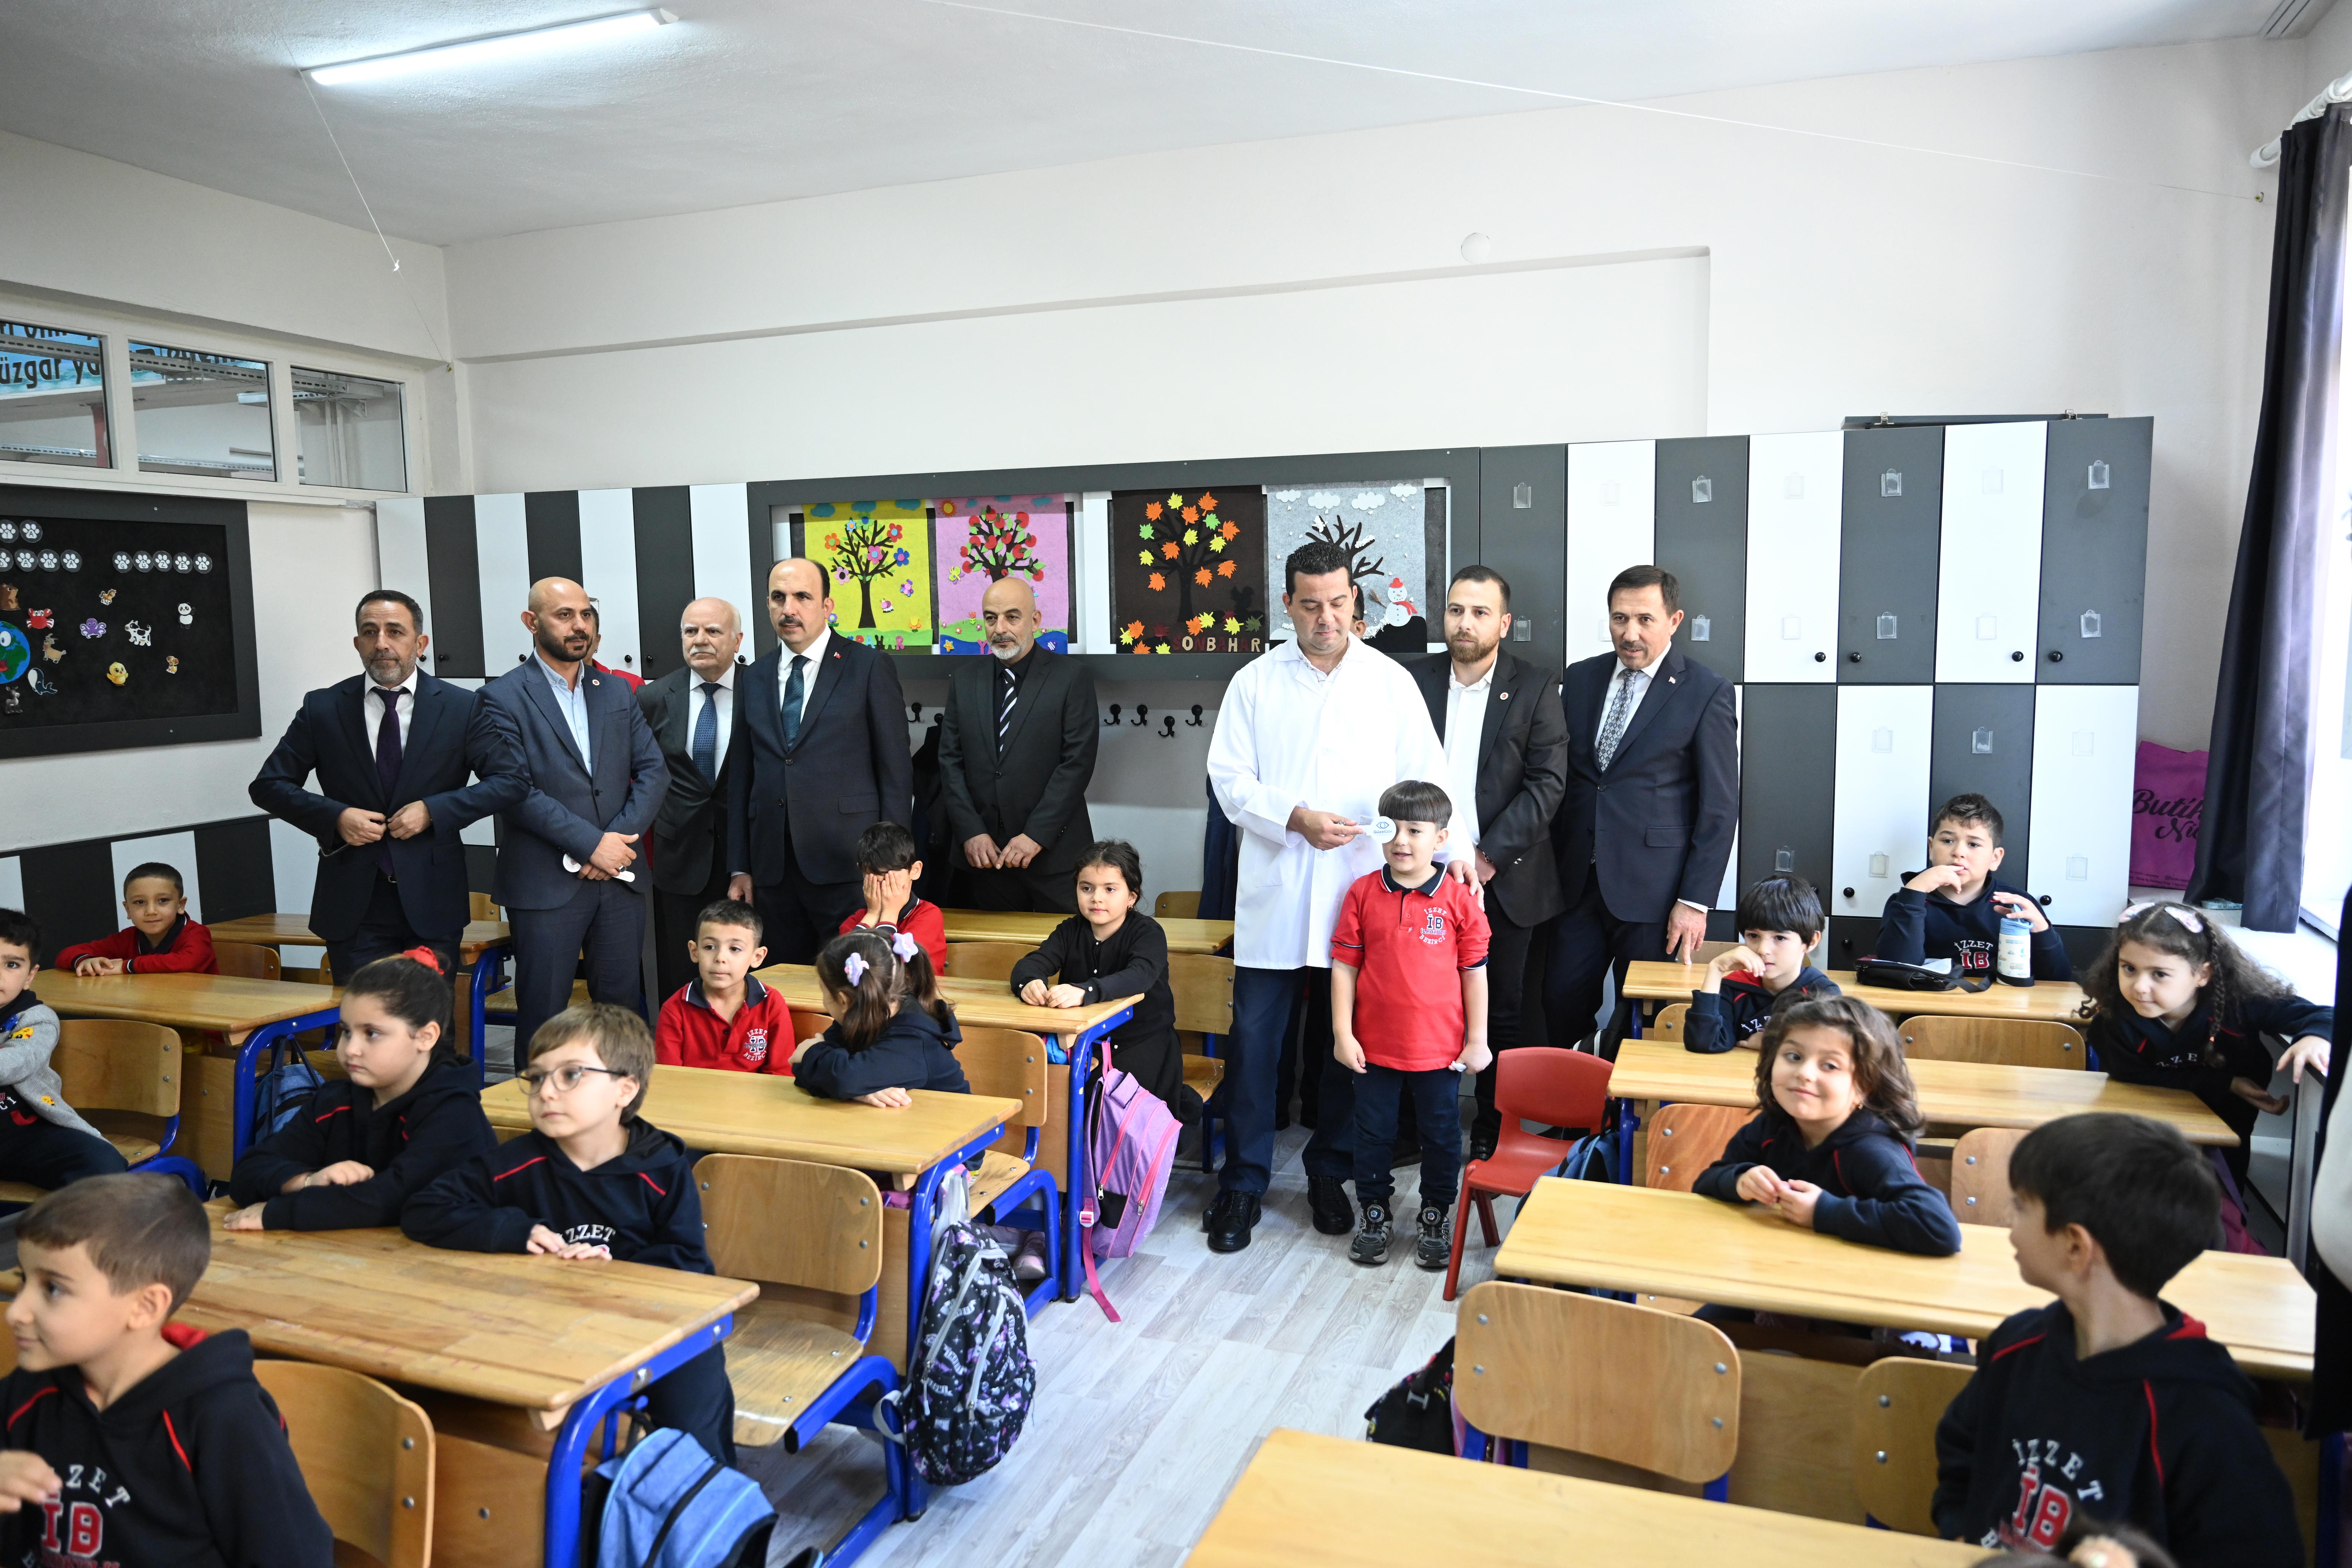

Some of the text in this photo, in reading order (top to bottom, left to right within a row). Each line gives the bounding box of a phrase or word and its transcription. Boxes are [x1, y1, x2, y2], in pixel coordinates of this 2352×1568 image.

[1173, 634, 1260, 652] SONBAHAR
[556, 1224, 616, 1243] ZZET
[51, 1464, 131, 1508] ZET
